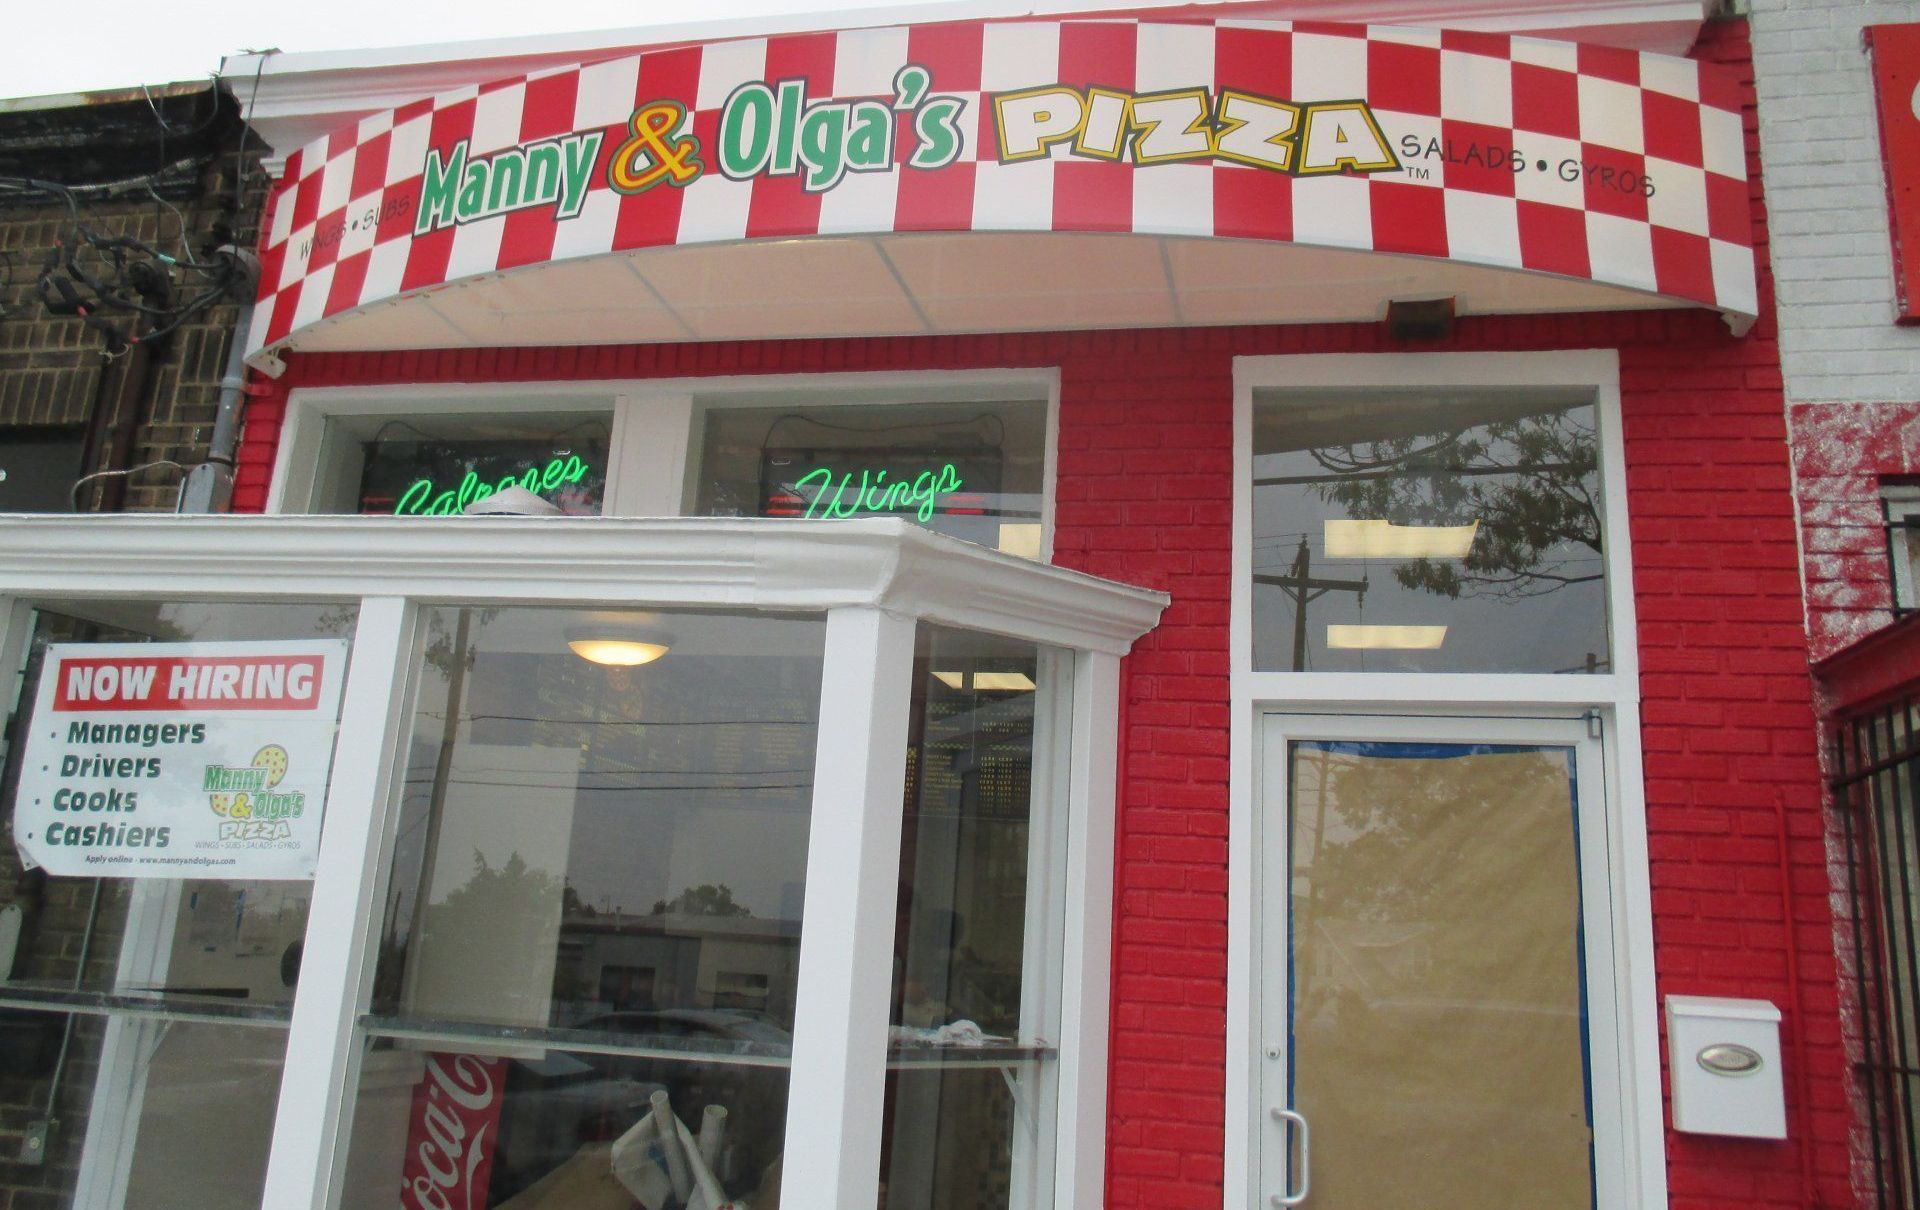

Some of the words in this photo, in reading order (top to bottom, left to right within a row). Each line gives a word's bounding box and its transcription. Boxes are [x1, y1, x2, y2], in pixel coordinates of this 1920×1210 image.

[412, 129, 605, 238] Manny
[608, 100, 703, 195] &
[717, 63, 969, 193] Olga's
[992, 83, 1403, 178] PIZZA
[1401, 134, 1526, 173] SALADS
[1558, 159, 1656, 198] GYROS
[300, 219, 347, 261] WINGS
[362, 195, 410, 231] SUBS
[794, 463, 963, 523] Wings
[66, 665, 156, 701] NOW
[168, 663, 315, 700] HIRING
[67, 721, 207, 748] Managers
[60, 754, 162, 778] Drivers
[203, 765, 269, 796] Manny
[53, 788, 138, 813] Cooks
[230, 793, 253, 819] &
[46, 822, 171, 848] Cashiers
[219, 820, 291, 840] PIZZA
[194, 841, 219, 849] WINGS
[247, 841, 273, 850] SALADS
[278, 841, 301, 850] GYROS
[85, 855, 108, 865] Apply
[108, 855, 133, 864] online
